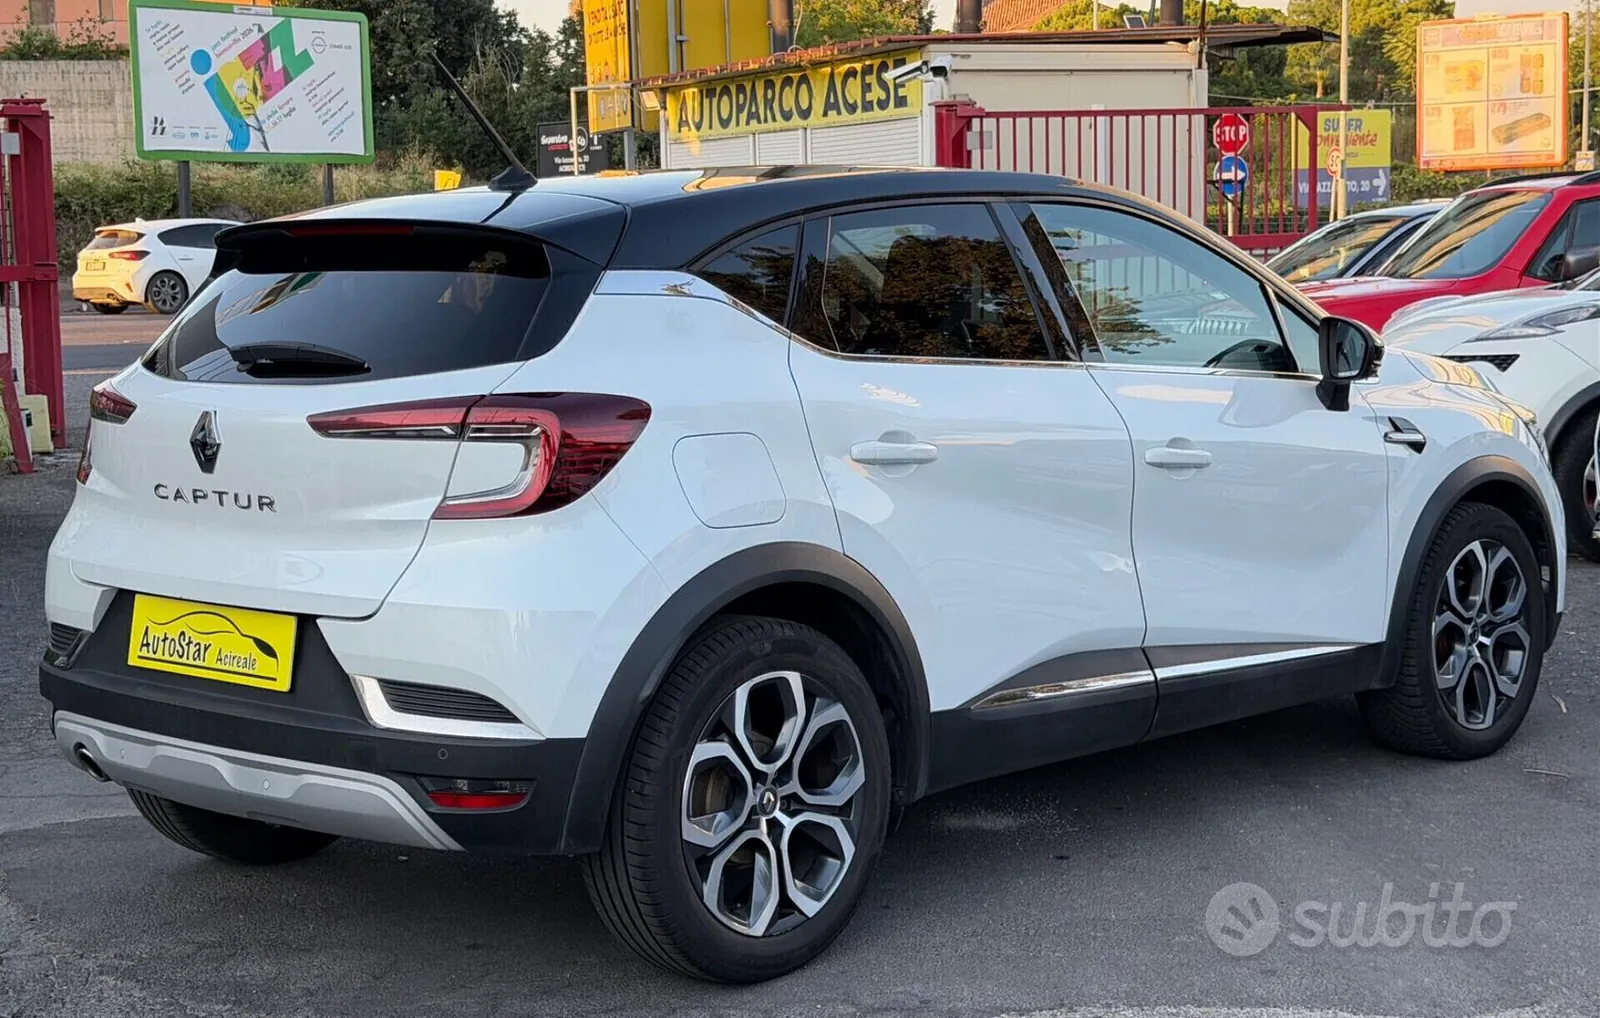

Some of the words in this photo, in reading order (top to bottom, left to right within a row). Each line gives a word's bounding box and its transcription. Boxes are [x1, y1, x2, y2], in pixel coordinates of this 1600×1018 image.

[678, 73, 813, 133] AUTOPARCO
[822, 58, 908, 117] ACESE
[1317, 129, 1378, 147] onveiente
[1324, 118, 1363, 132] SUER
[153, 483, 277, 513] CAPTUR
[139, 625, 212, 662] AutoStar
[215, 648, 257, 671] Acireale
